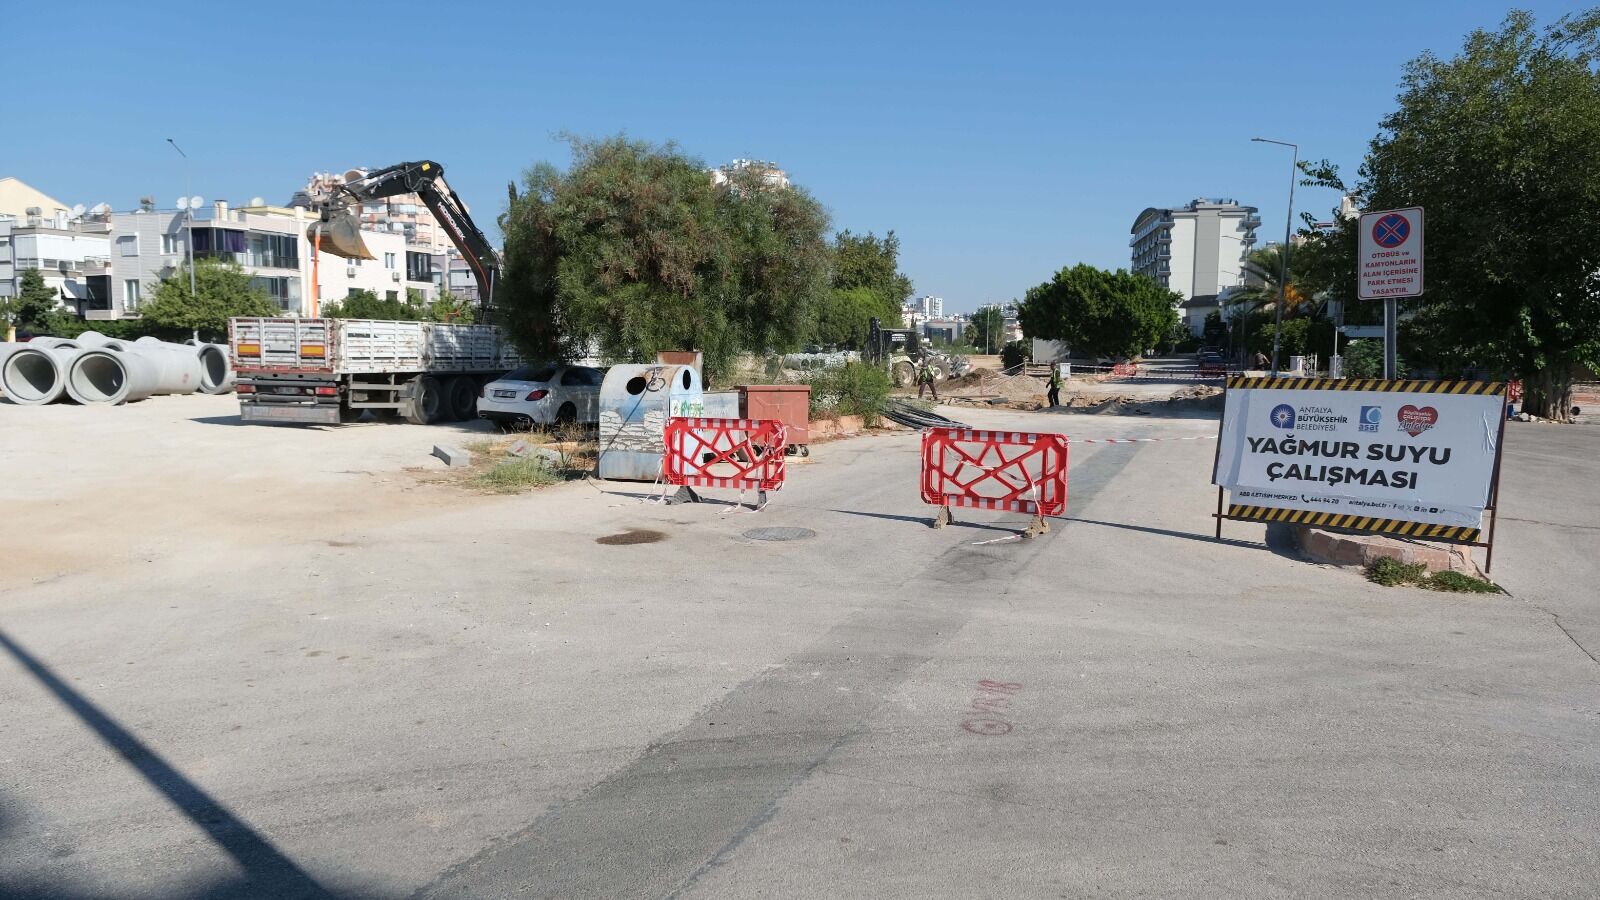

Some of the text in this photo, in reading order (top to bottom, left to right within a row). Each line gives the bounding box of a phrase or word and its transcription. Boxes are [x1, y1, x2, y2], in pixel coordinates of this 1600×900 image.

[1363, 270, 1382, 278] ALAN
[1299, 406, 1333, 414] ANTALYA
[1297, 413, 1348, 424] BÜYÜKŞEHİR
[1296, 423, 1336, 432] BELEDİYESİ
[1247, 434, 1452, 466] YAĞMUR SUYU
[1266, 461, 1418, 490] ÇALIŞMASI
